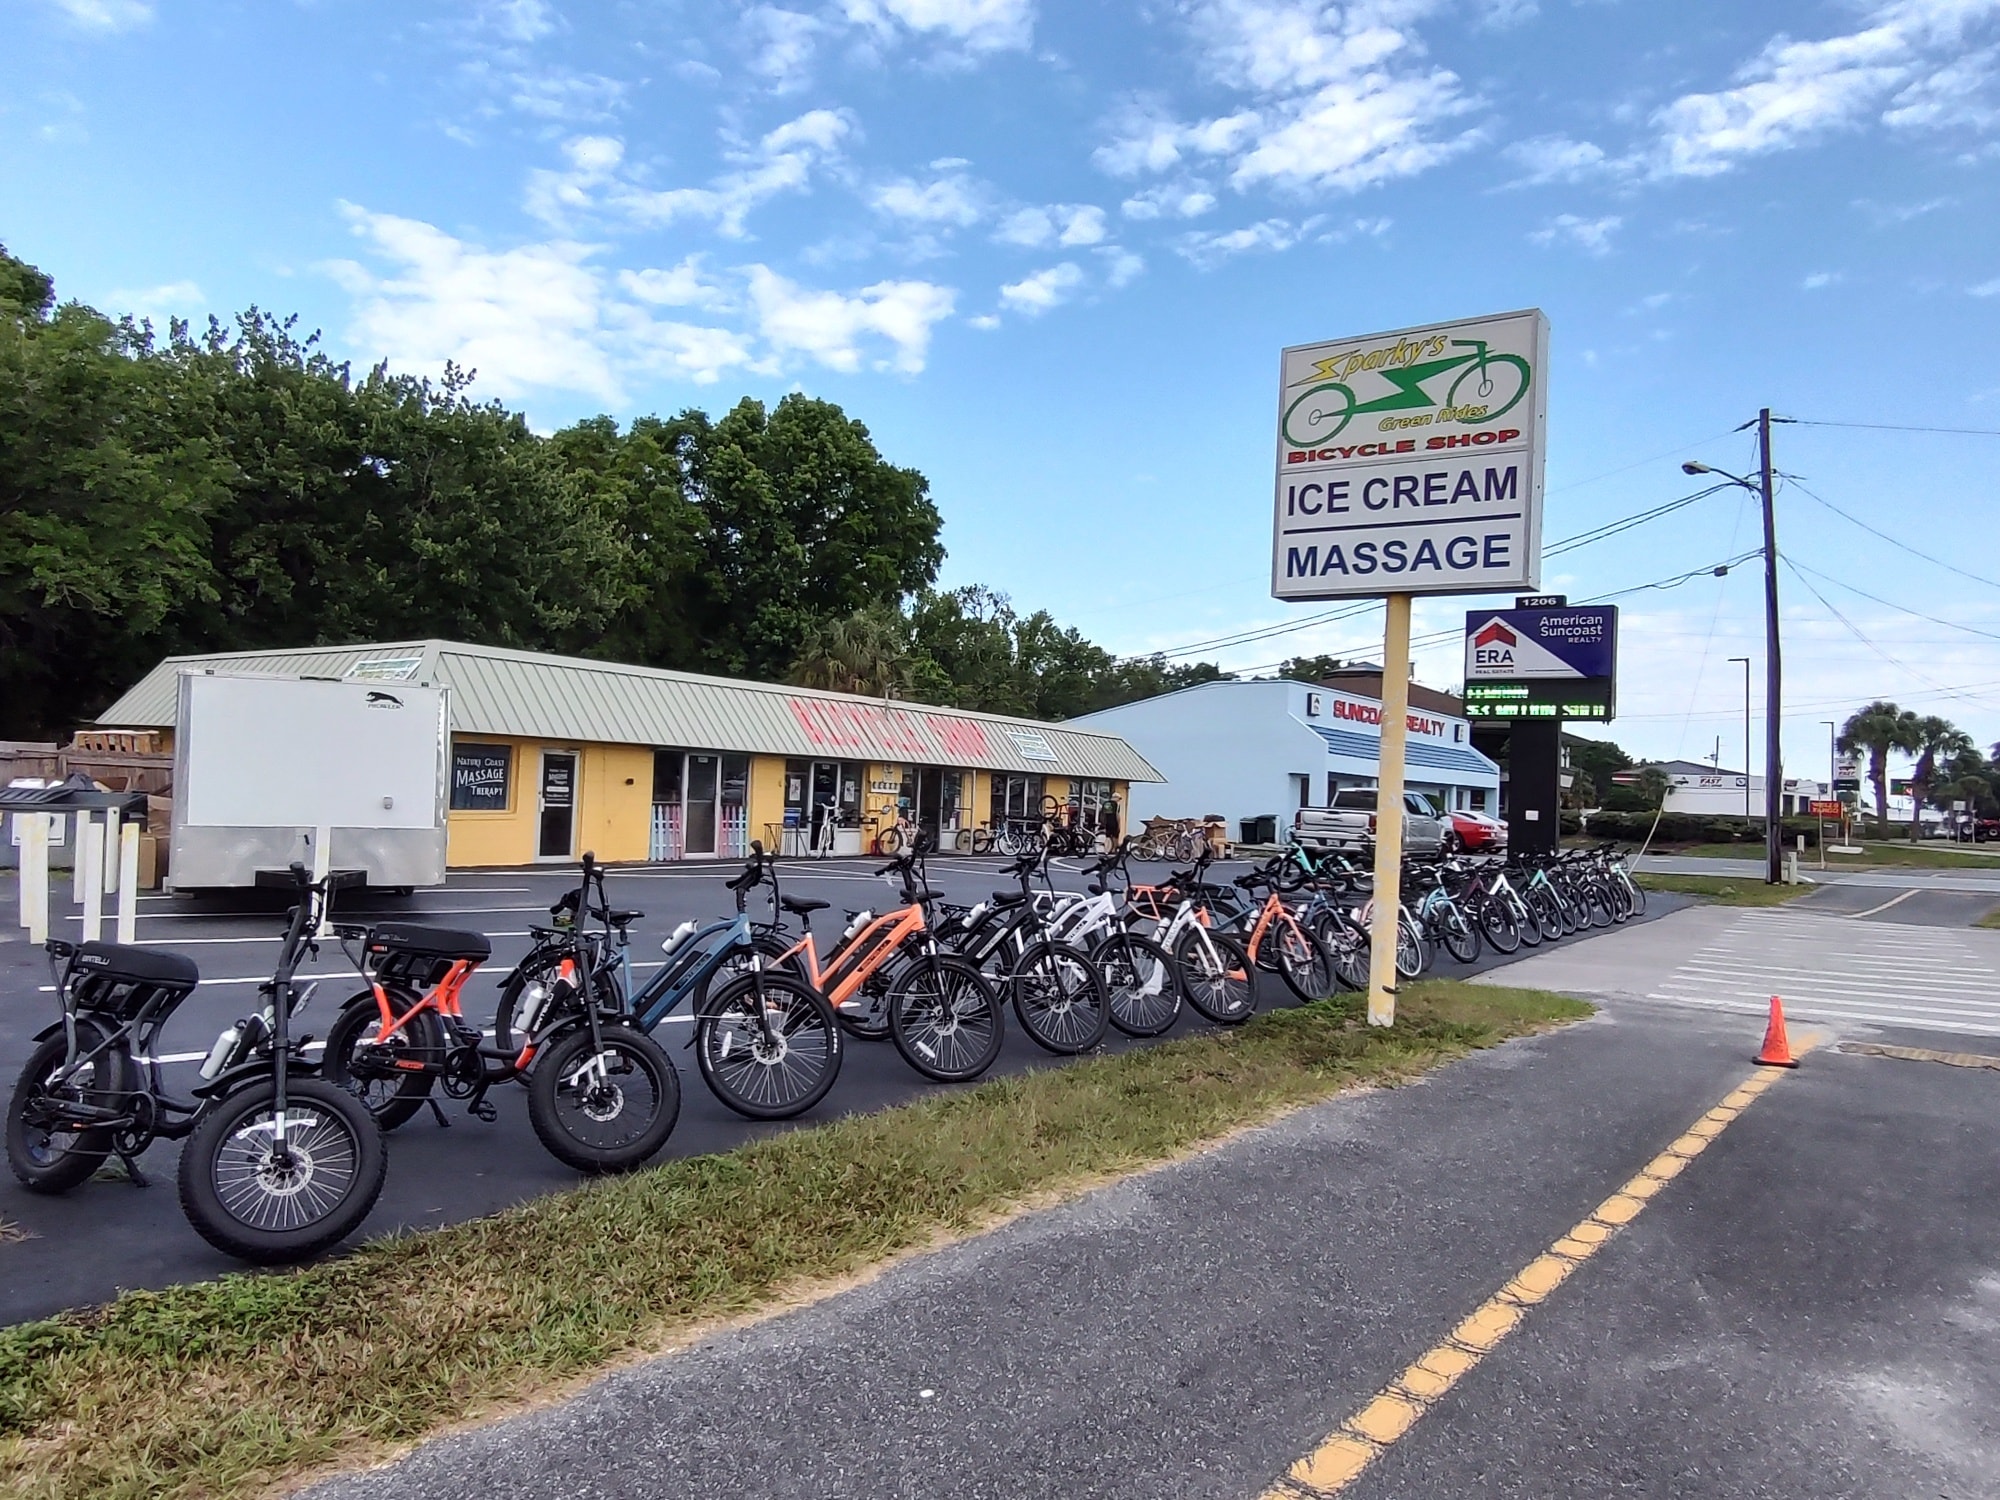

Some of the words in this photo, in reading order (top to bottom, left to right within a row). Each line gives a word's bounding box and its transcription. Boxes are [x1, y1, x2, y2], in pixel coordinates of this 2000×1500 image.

[1287, 335, 1448, 388] Sparky's
[1378, 413, 1433, 432] Green
[1435, 403, 1489, 424] Rides
[1287, 439, 1416, 465] BICYCLE
[1426, 429, 1521, 450] SHOP
[1287, 480, 1350, 517] ICE
[1362, 465, 1518, 511] CREAM
[1286, 533, 1511, 578] MASSAGE
[1522, 597, 1557, 606] 1206
[1539, 614, 1603, 627] American
[1540, 624, 1603, 637] Suncoast
[1567, 636, 1602, 644] REALTY
[1475, 649, 1515, 664] ERA
[1332, 699, 1382, 726] SUNCOA
[1405, 714, 1446, 737] REALTY
[456, 768, 504, 788] MASSAGE
[470, 785, 503, 798] THERAPY
